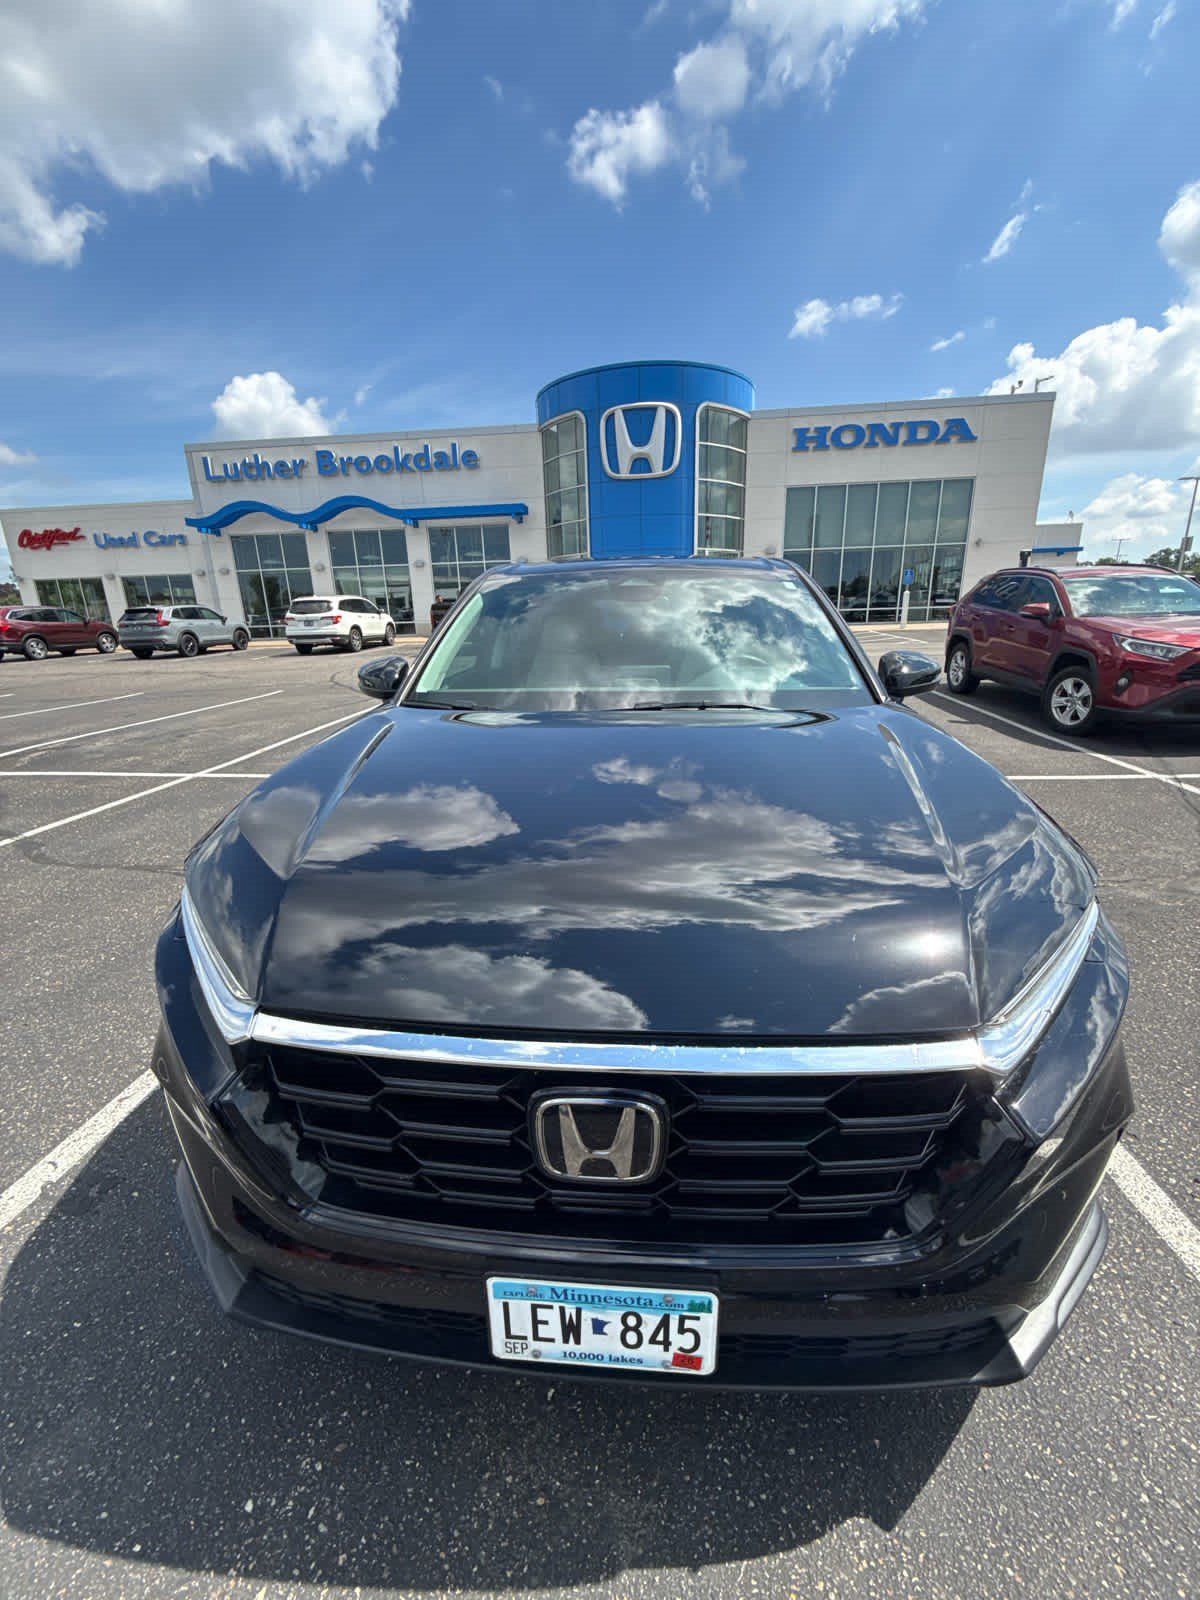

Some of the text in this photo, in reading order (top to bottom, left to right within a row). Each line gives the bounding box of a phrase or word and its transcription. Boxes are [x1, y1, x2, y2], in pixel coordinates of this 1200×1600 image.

[791, 417, 978, 453] HONDA
[202, 442, 480, 482] Luther Brookdale
[93, 531, 139, 550] Used
[143, 530, 187, 547] Cars
[502, 1301, 701, 1354] LEW 845
[504, 1341, 529, 1355] SEP
[562, 1350, 644, 1365] 10,000 lakes
